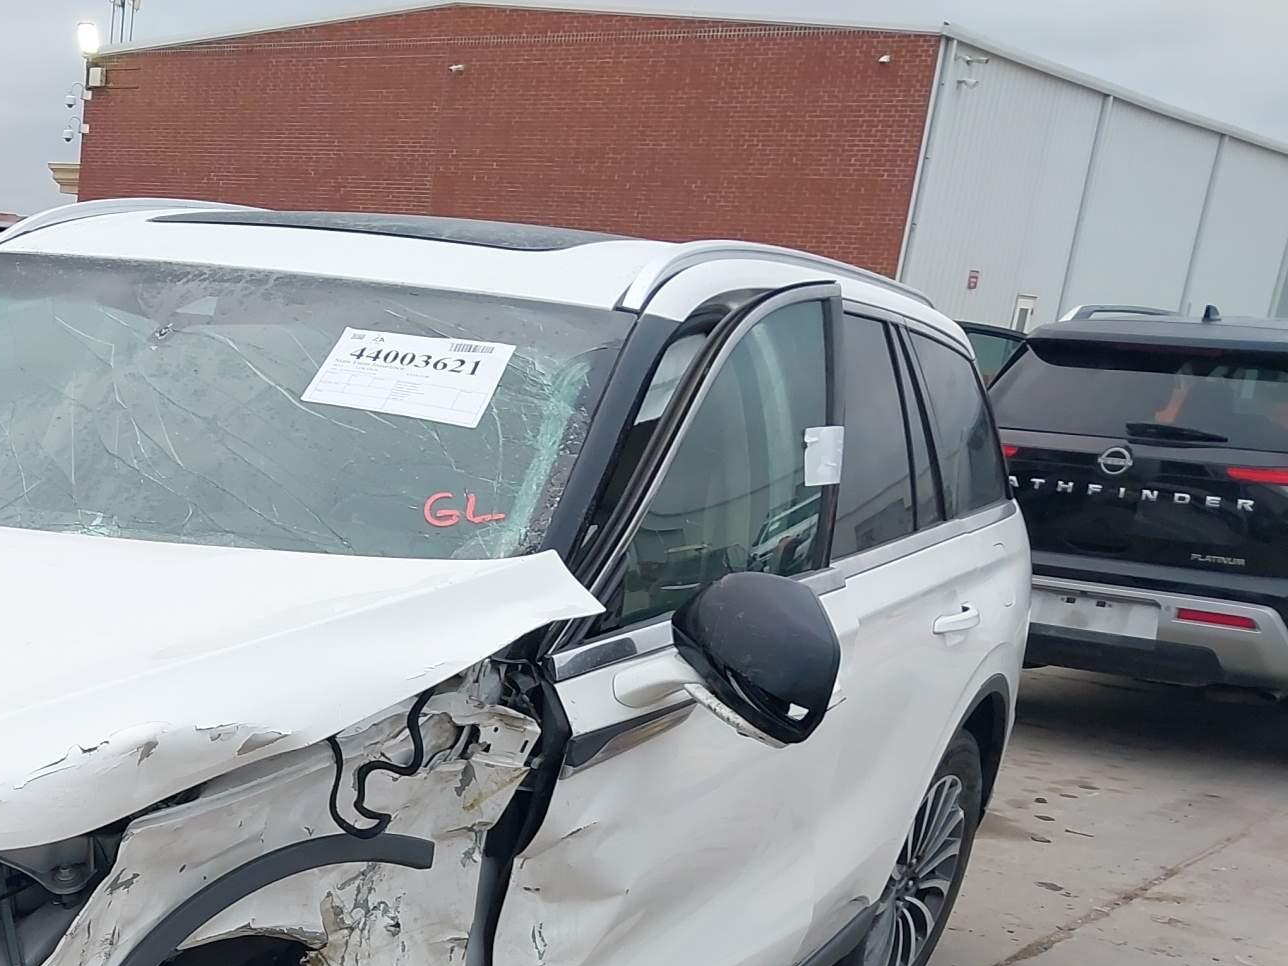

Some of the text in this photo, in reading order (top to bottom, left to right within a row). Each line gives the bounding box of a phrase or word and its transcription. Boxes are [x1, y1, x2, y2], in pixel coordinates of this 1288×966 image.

[349, 345, 482, 376] 44003621
[423, 490, 505, 528] GL
[1008, 475, 1256, 513] ATHFINDER
